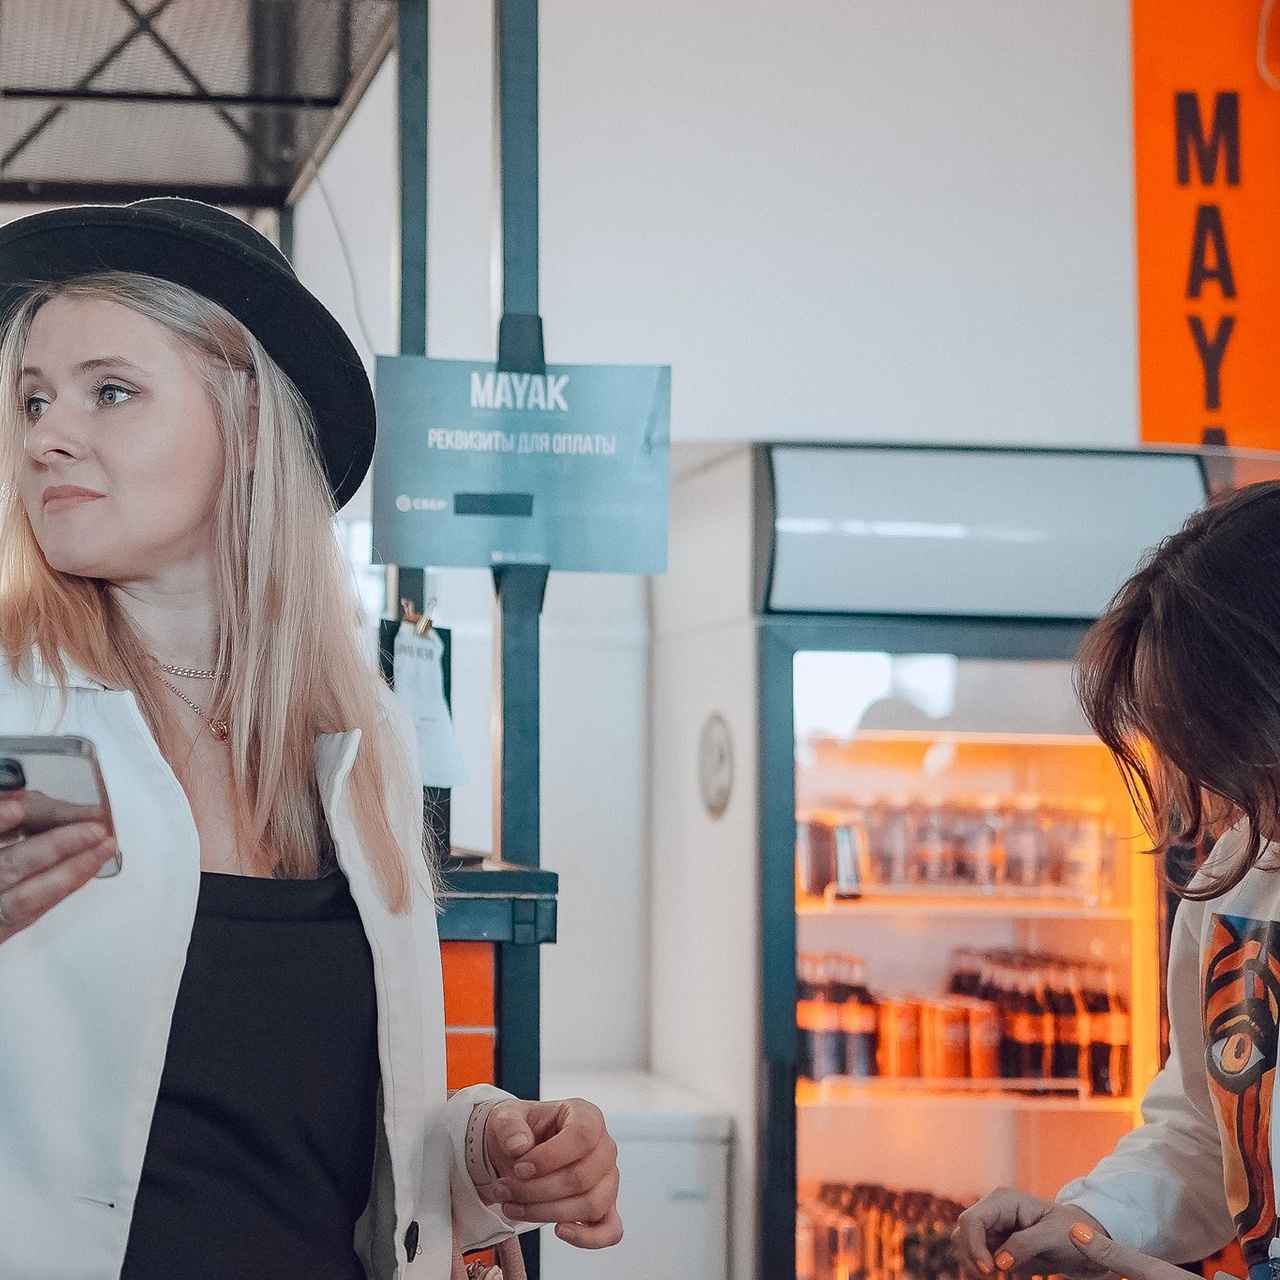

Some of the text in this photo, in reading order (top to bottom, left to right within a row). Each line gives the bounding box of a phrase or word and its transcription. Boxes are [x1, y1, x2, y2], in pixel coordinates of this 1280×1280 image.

[470, 371, 570, 411] MAYAK
[428, 427, 616, 455] РЕКВИЗИТЫ ДЛЯ ОПЛАТЫ
